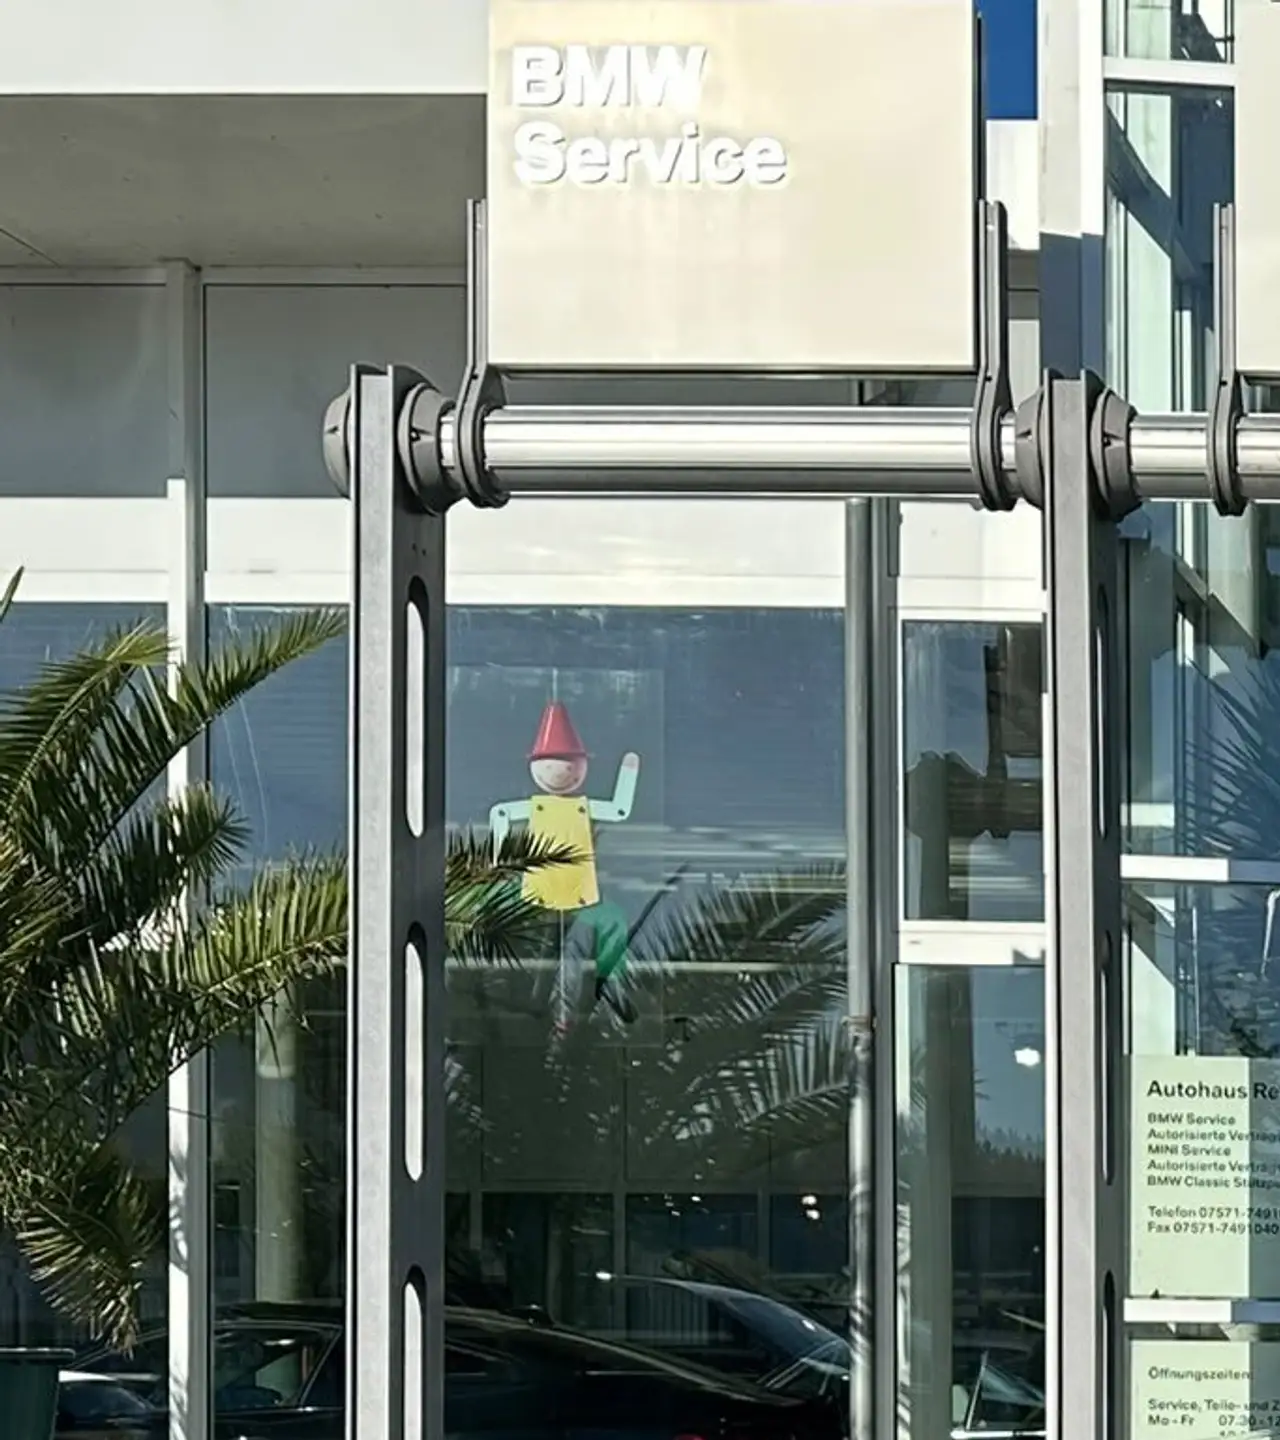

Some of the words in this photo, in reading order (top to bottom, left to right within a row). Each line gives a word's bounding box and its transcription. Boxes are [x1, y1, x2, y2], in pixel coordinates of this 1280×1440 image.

[511, 43, 707, 109] BMW
[513, 121, 788, 186] Service
[1147, 1080, 1248, 1099] Autohaus
[1147, 1112, 1184, 1125] BMW
[1186, 1112, 1237, 1126] Service
[1147, 1130, 1226, 1143] Autorisierte
[1147, 1144, 1179, 1156] MINI
[1181, 1144, 1232, 1157] Service
[1147, 1160, 1226, 1173] Autorisierte
[1147, 1175, 1182, 1188] BMW
[1184, 1175, 1231, 1188] Classic
[1147, 1205, 1197, 1219] Telefon
[1147, 1221, 1171, 1234] Fax
[1147, 1399, 1202, 1413] Service,
[1203, 1399, 1241, 1412] Teile-
[1243, 1400, 1268, 1412] und
[1147, 1414, 1170, 1427] Mo
[1180, 1415, 1195, 1427] Fr
